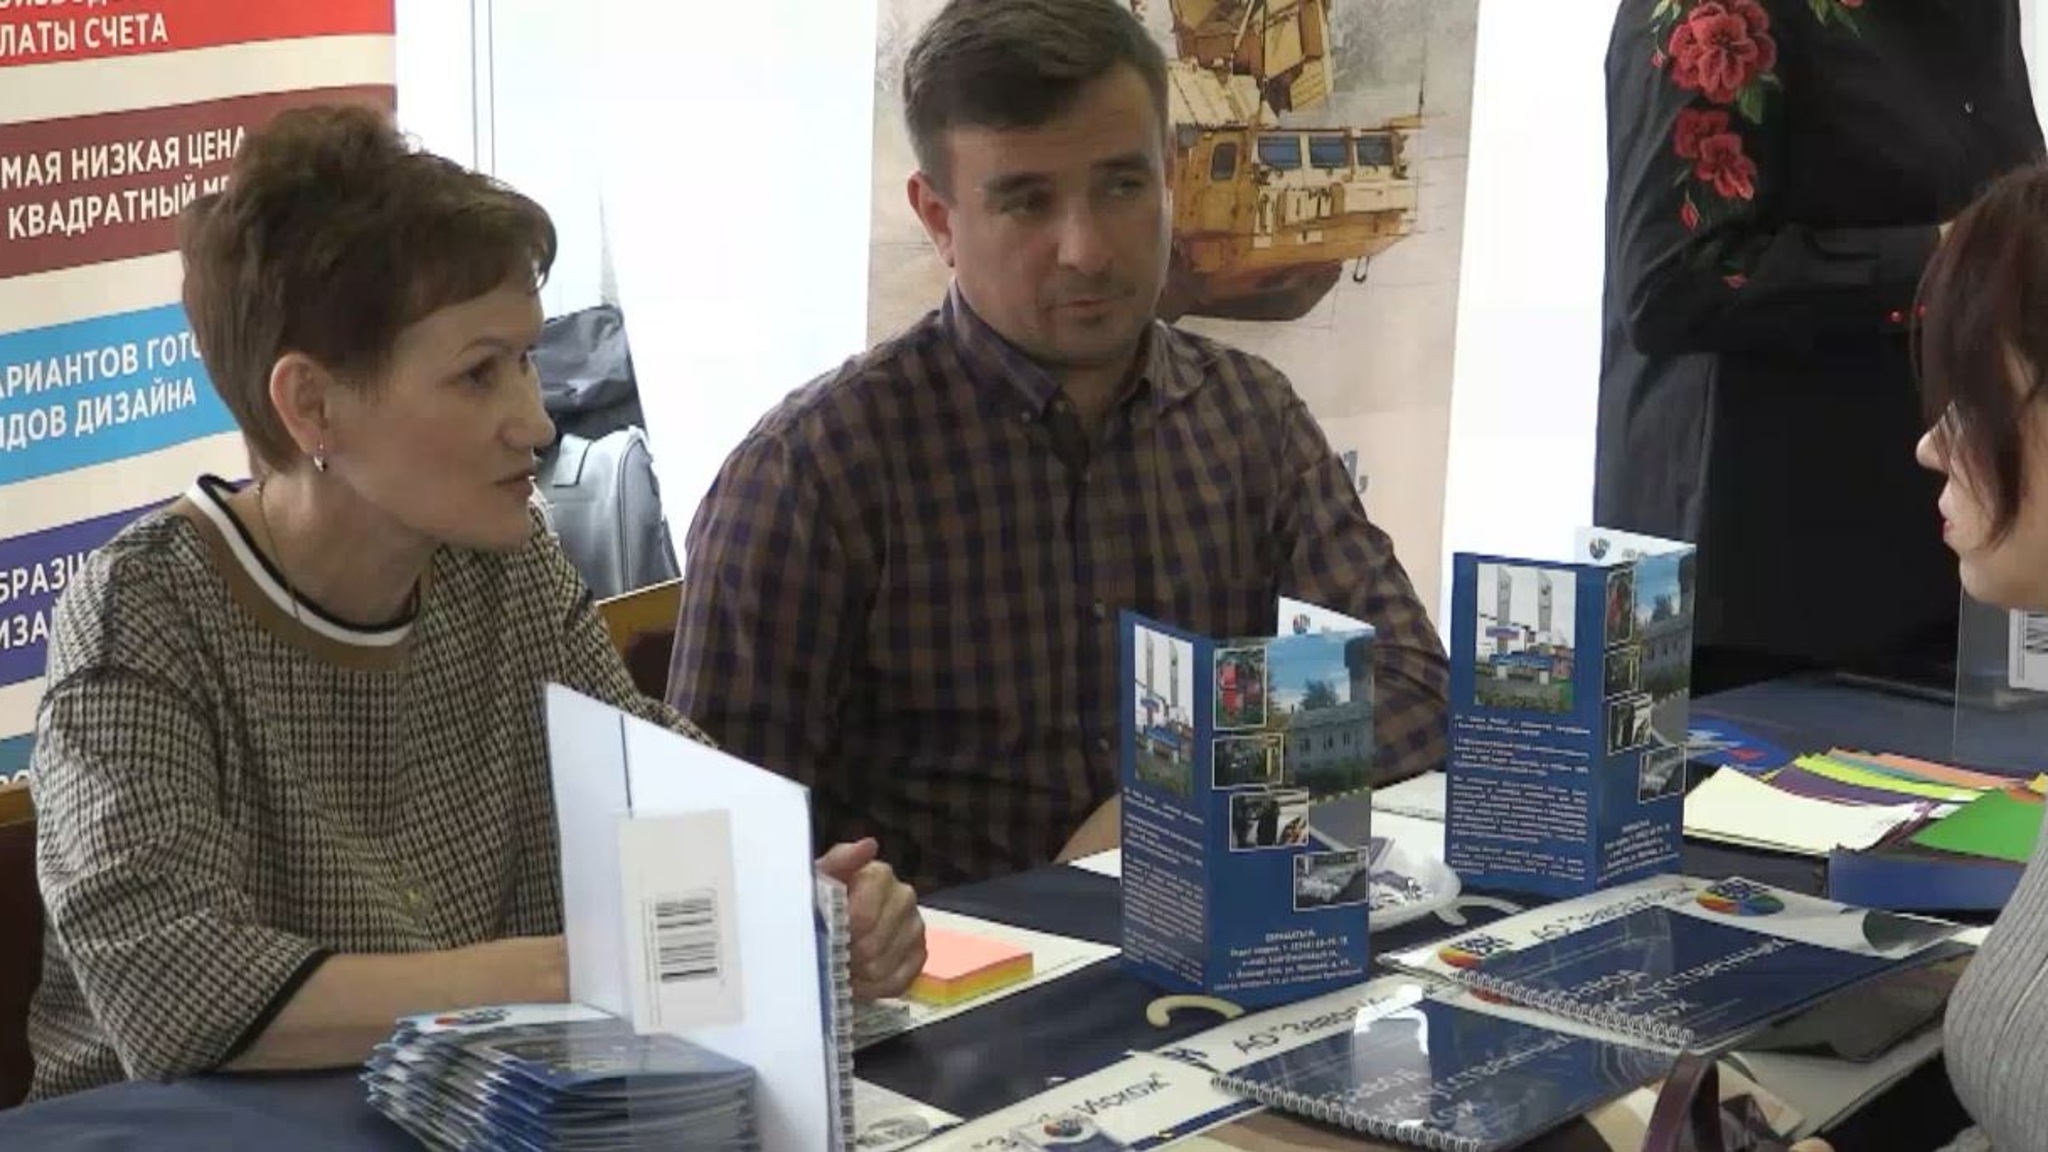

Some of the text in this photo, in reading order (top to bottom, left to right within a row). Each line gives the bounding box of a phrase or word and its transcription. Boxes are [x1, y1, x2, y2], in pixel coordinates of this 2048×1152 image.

[84, 12, 168, 48] СЧЕТА
[0, 152, 61, 190] МАЯ
[71, 135, 180, 181] НИЗКАЯ
[7, 173, 196, 240] КВАДРАТНЫЙ
[75, 376, 197, 437] ДИЗАЙНА
